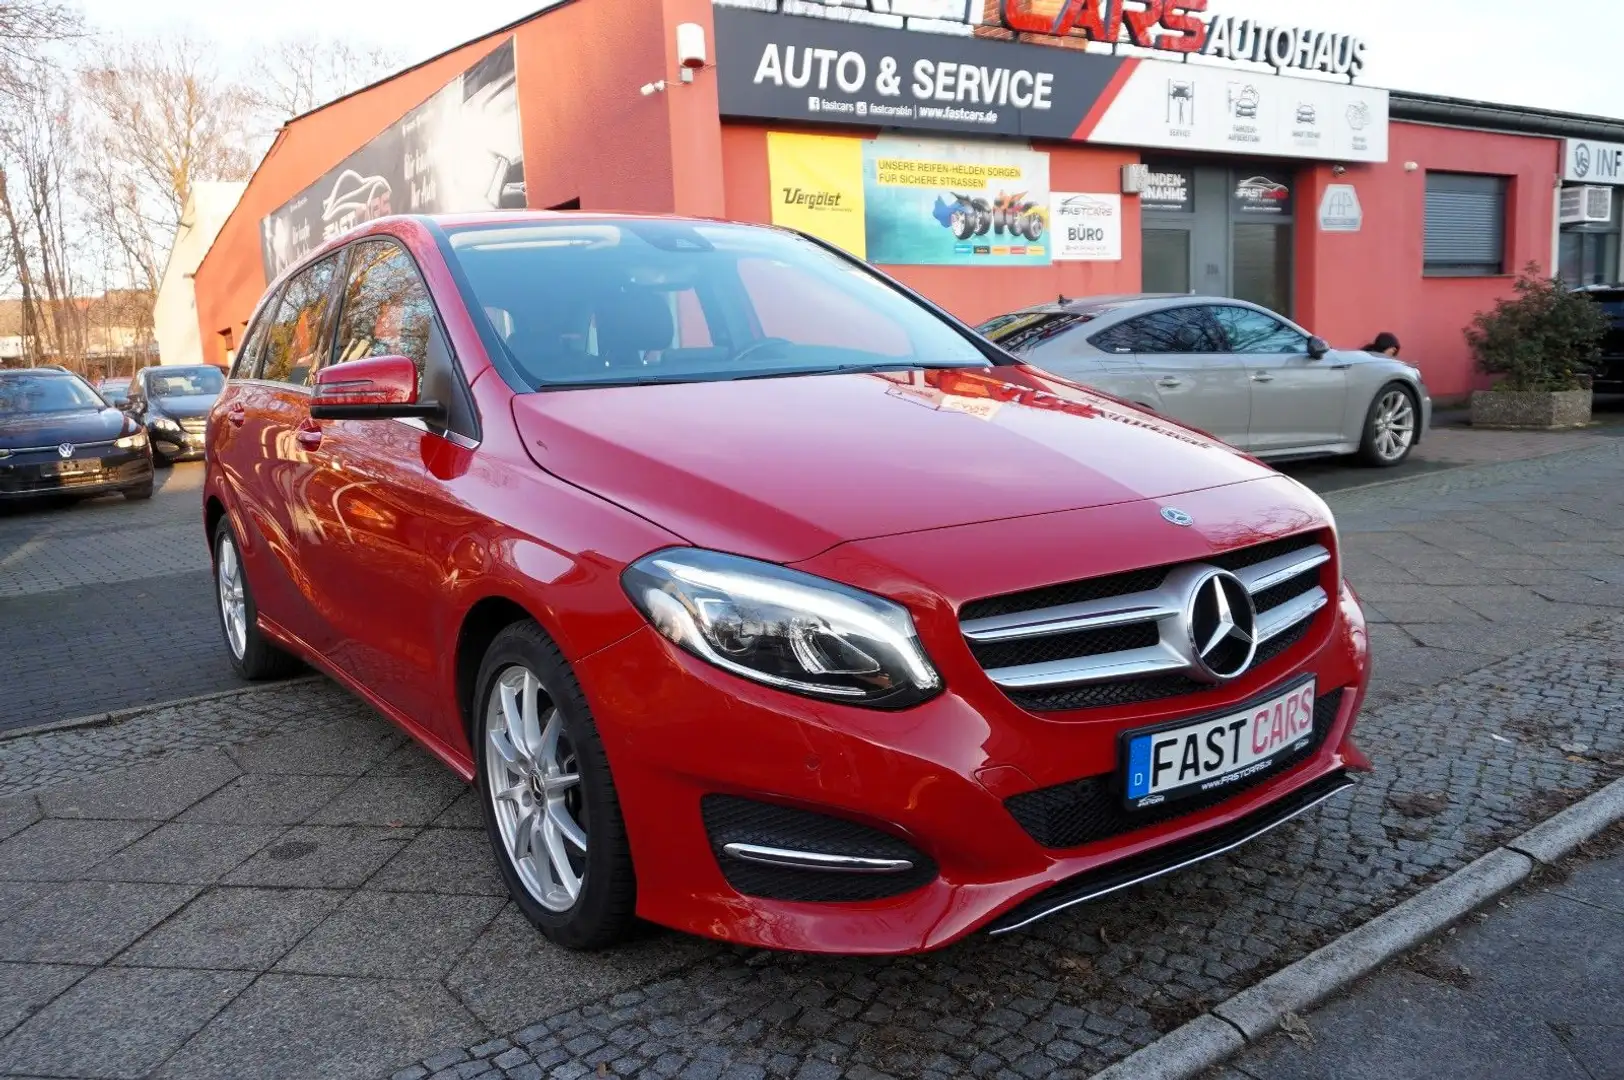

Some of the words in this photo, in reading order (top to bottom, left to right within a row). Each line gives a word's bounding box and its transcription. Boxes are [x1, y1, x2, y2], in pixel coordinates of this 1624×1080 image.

[1201, 14, 1368, 77] AUTOHAUS
[753, 43, 867, 93] AUTO
[875, 55, 901, 96] &
[911, 58, 1054, 109] SERVICE
[822, 98, 854, 112] fastcars
[919, 106, 998, 122] www.fastcars.de
[878, 160, 915, 172] UNSERE
[917, 162, 985, 176] REIFEN-HELDEN
[987, 166, 1021, 177] SORGEN
[900, 174, 938, 185] SICHERE
[940, 176, 985, 188] STRASSEN!
[782, 187, 842, 209] Vergölst
[1067, 223, 1104, 241] BÜRO
[1134, 772, 1143, 786] D
[1152, 718, 1248, 787] FAST
[1252, 687, 1313, 754] CARS
